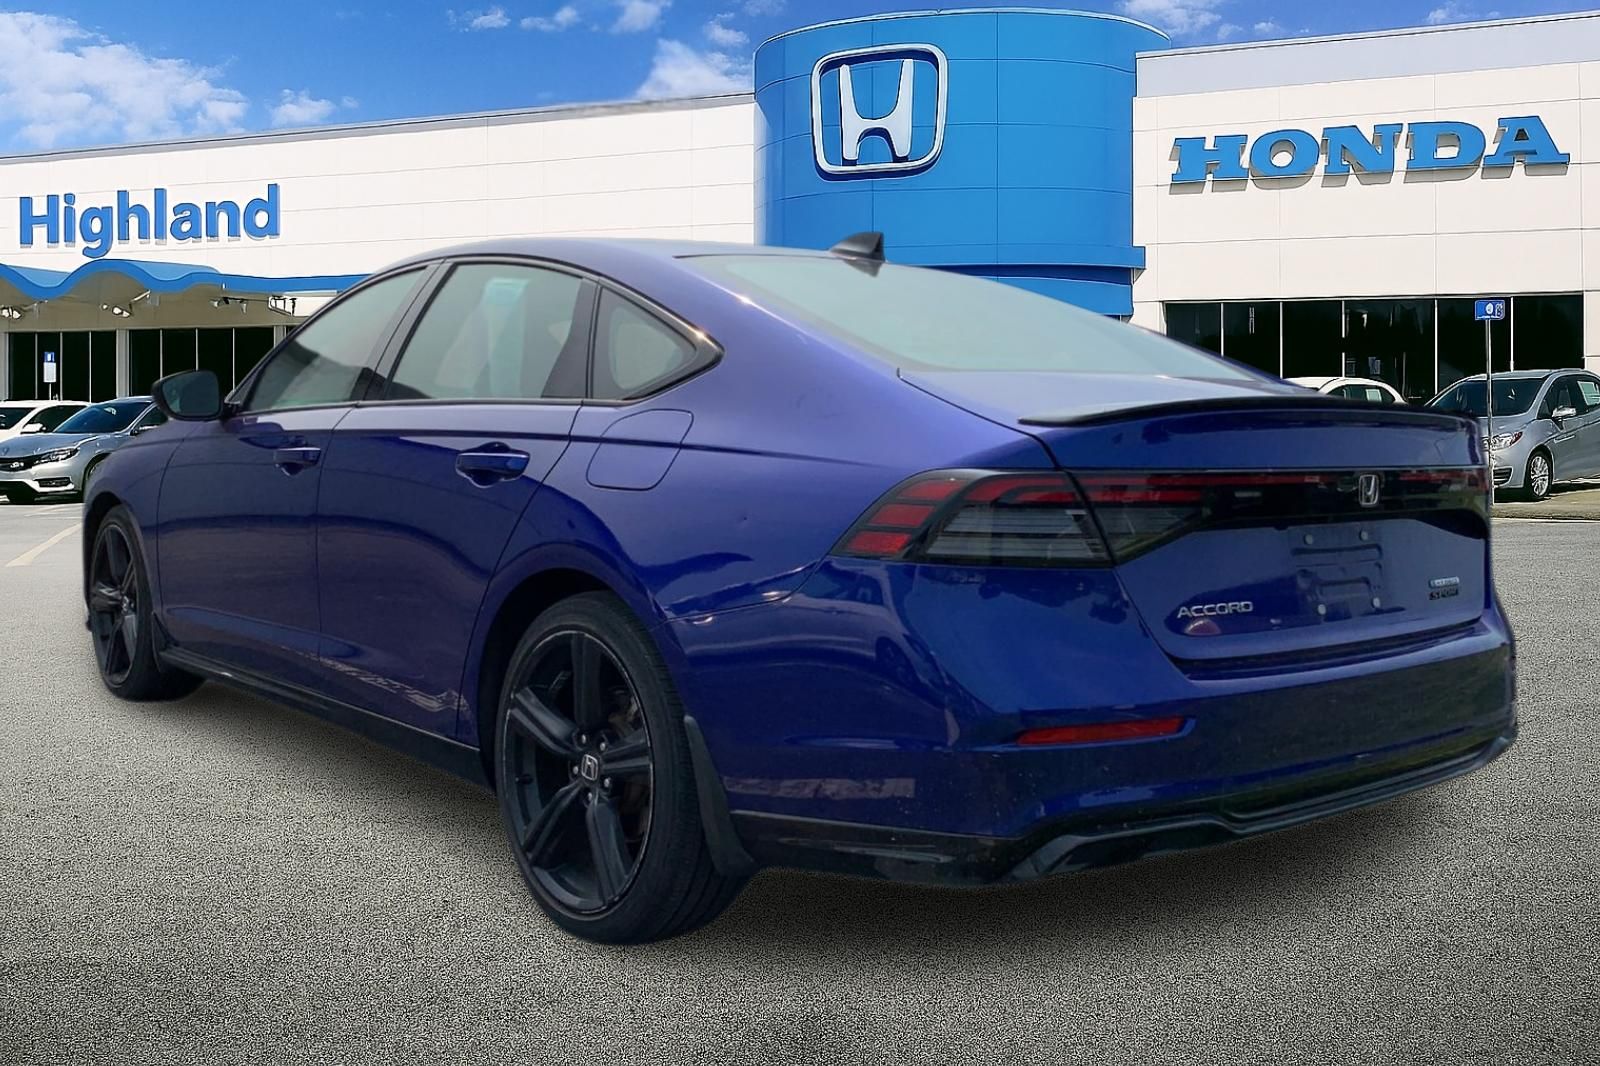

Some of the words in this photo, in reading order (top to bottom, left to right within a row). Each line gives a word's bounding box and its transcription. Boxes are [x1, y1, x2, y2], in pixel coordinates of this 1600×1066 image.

[1170, 115, 1570, 184] HONDA
[19, 183, 280, 258] Highland
[1176, 601, 1254, 619] ACCORD
